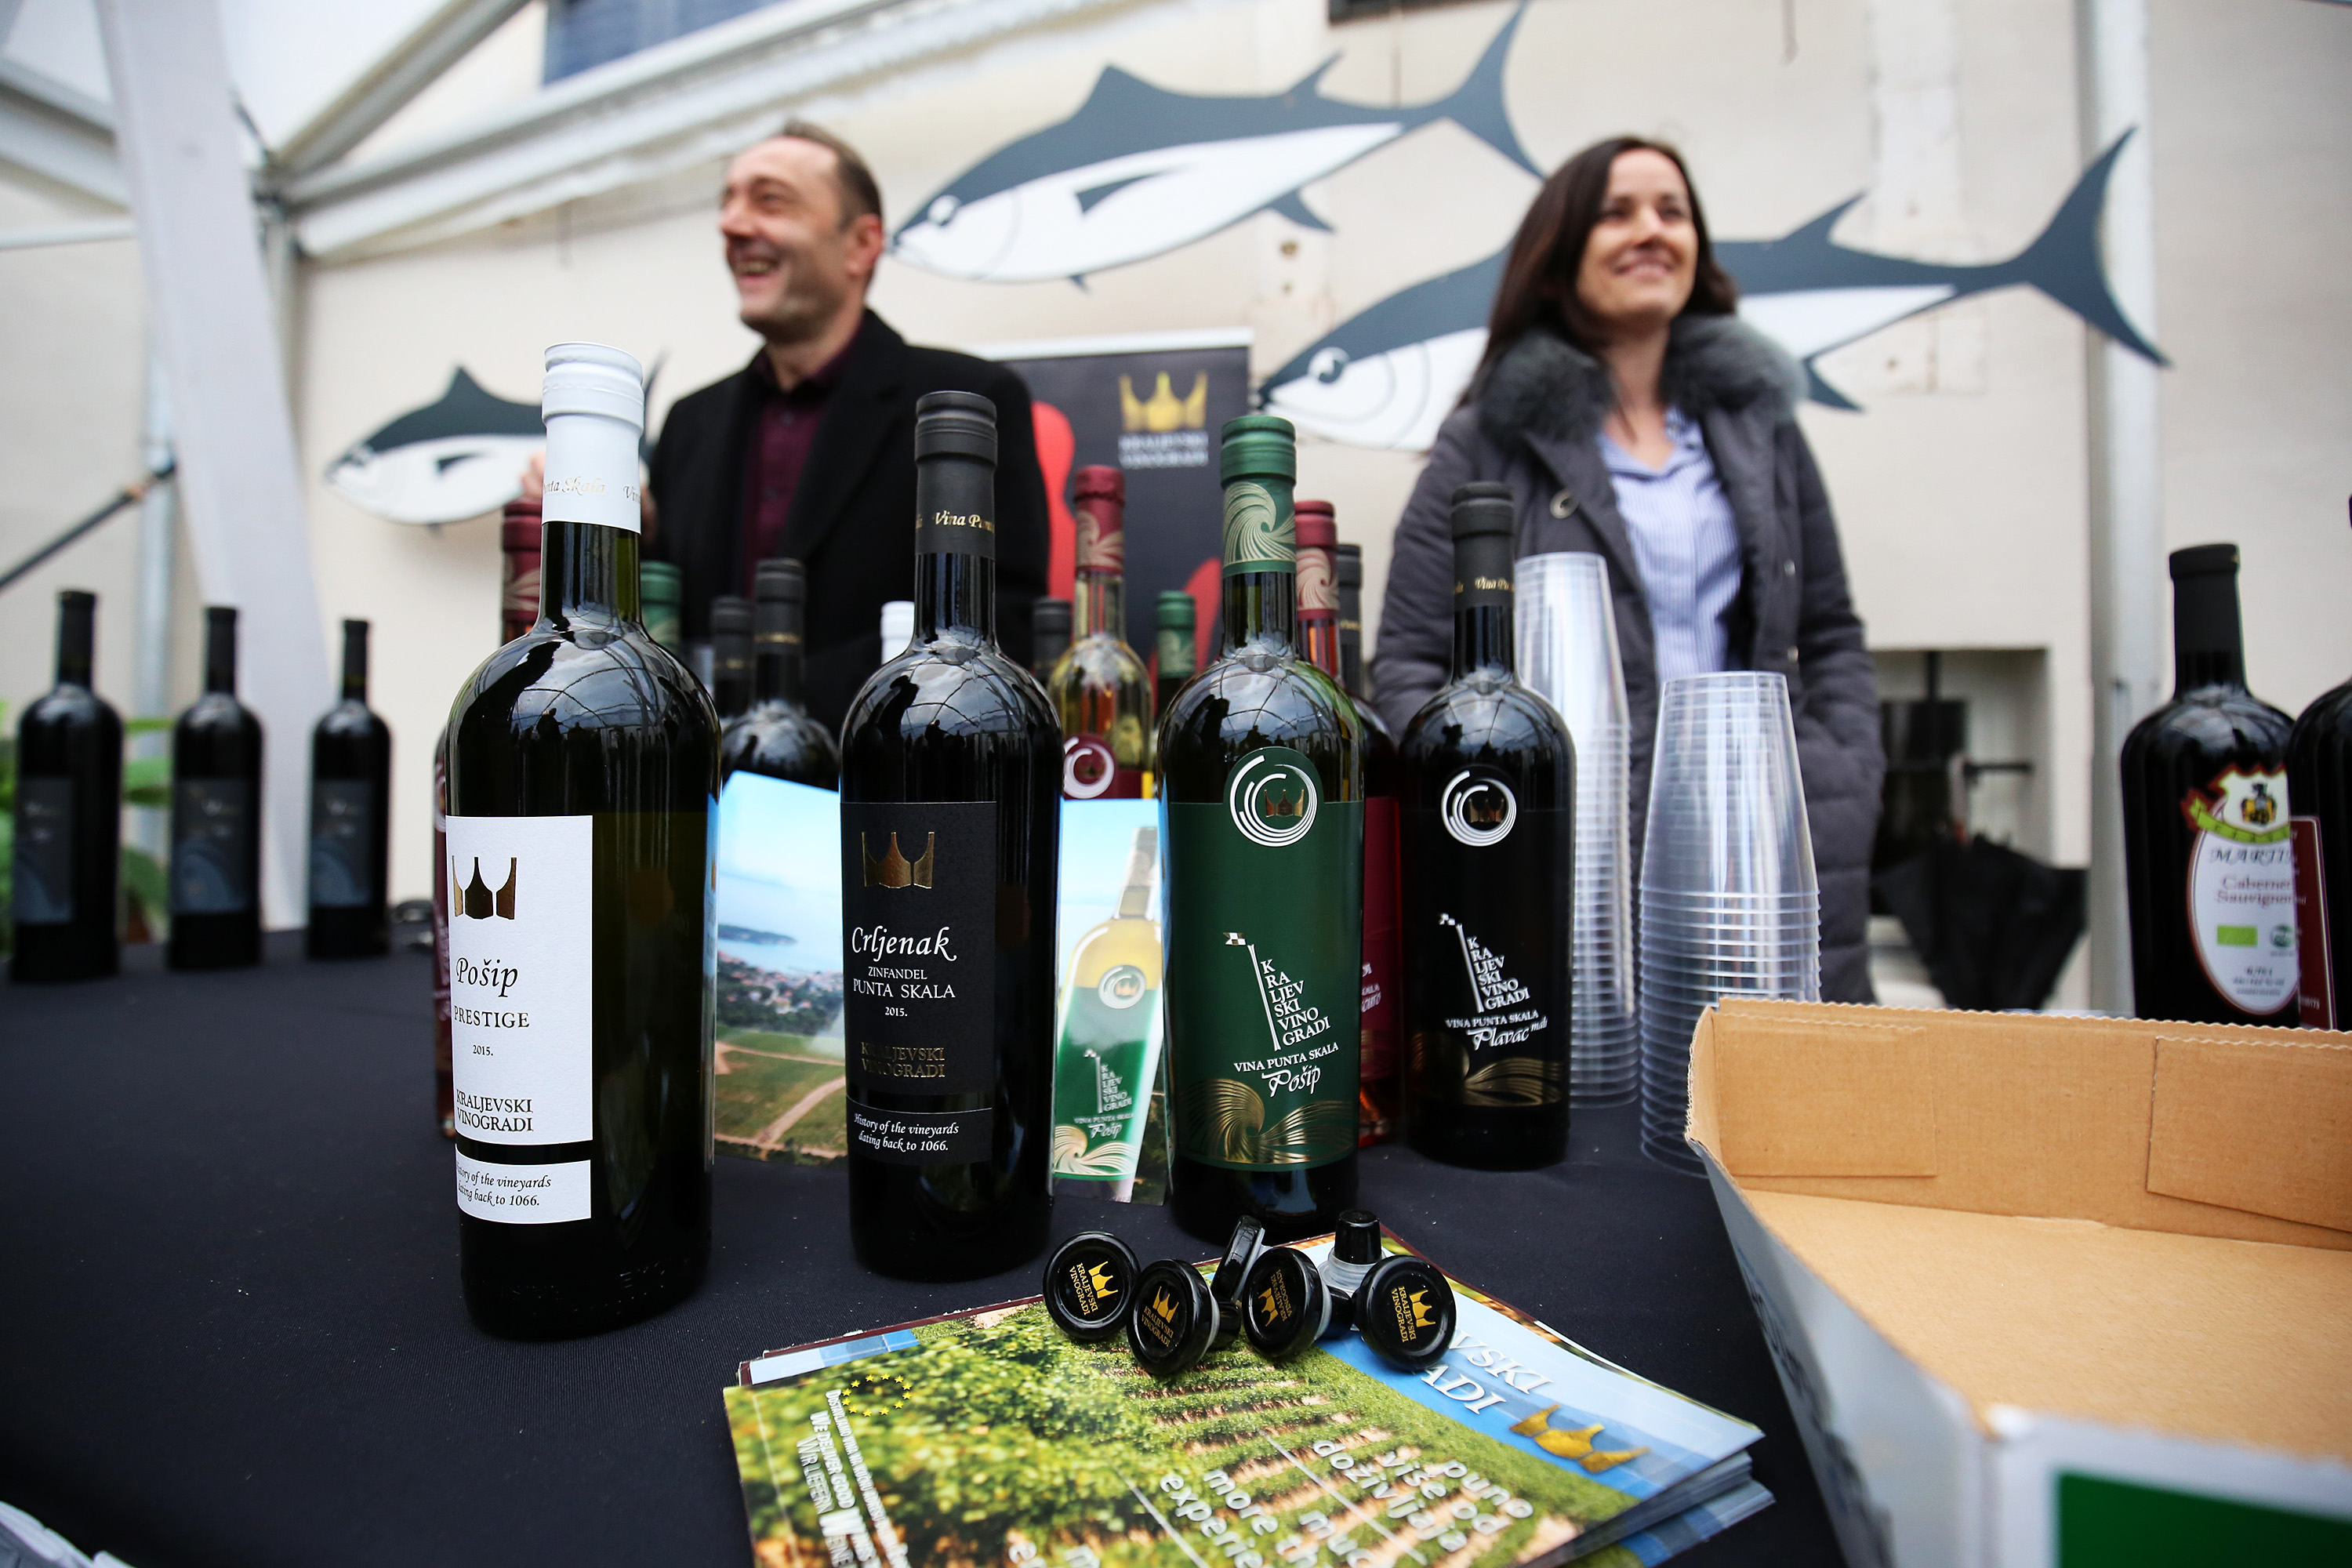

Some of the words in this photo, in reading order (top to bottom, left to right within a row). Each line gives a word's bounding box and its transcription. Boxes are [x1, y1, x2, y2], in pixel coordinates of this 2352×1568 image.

[561, 476, 606, 496] Skala
[935, 510, 967, 526] Vina
[851, 925, 957, 962] Crljenak
[1467, 935, 1480, 950] K
[1470, 946, 1494, 962] RA
[868, 966, 928, 980] ZINFANDEL
[1260, 959, 1276, 975] K
[1473, 954, 1505, 975] LJEV
[456, 957, 519, 998] Pošip
[853, 978, 894, 998] PUNTA
[900, 983, 956, 999] SKALA
[1265, 971, 1291, 989] RA
[1477, 970, 1502, 986] SKI
[1480, 977, 1519, 997] VINO
[1269, 980, 1305, 1004] LJEV
[1484, 986, 1531, 1011] GRADI
[453, 1005, 530, 1029] PRESTIGE
[884, 1007, 908, 1017] 2015.
[1273, 998, 1302, 1018] SKI
[1277, 1007, 1319, 1032] VINO
[1445, 1018, 1471, 1029] VINA
[1471, 1015, 1508, 1028] PUNTA
[1508, 1009, 1540, 1024] SKALA
[1282, 1016, 1331, 1047] GRADI
[1465, 1025, 1530, 1051] Plavac
[473, 1044, 494, 1056] 2015.
[1233, 1061, 1266, 1073] VINA
[1266, 1053, 1308, 1069] PUNTA
[1308, 1042, 1340, 1061] SKALA
[1261, 1065, 1322, 1098] Pošip
[456, 1088, 534, 1113] KRALJEVSKI
[457, 1106, 534, 1132] VINOGRADI
[853, 1112, 879, 1133] History
[879, 1120, 891, 1134] of
[891, 1121, 906, 1134] the
[908, 1122, 960, 1138] vineyards
[858, 1130, 881, 1149] dating
[882, 1136, 906, 1152] back
[906, 1141, 917, 1151] to
[920, 1140, 949, 1152] 1066.
[471, 1171, 481, 1186] of
[481, 1173, 495, 1186] the
[496, 1174, 552, 1192] vineyards
[474, 1188, 495, 1207] back
[495, 1195, 506, 1206] to
[509, 1194, 540, 1207] 1066.
[1069, 1265, 1091, 1316] VINOGRADI
[1076, 1262, 1098, 1312] KRALJEVSKI
[1270, 1274, 1288, 1322] KRALJEVSKI
[1276, 1269, 1293, 1318] VINOGRADI
[1143, 1305, 1174, 1339] KRALJEVSKI
[1391, 1289, 1409, 1343] VINOGRADI
[1398, 1285, 1417, 1341] KRALJEVSKI
[1141, 1314, 1171, 1348] VINOGRADI
[809, 1410, 832, 1433] WE
[816, 1431, 844, 1476] DELIVER
[831, 1473, 856, 1509] GOOD
[1428, 1459, 1534, 1519] puno
[1203, 1468, 1279, 1537] more
[1159, 1473, 1276, 1568] experie
[1450, 1498, 1513, 1535] od
[1298, 1510, 1377, 1568] muc
